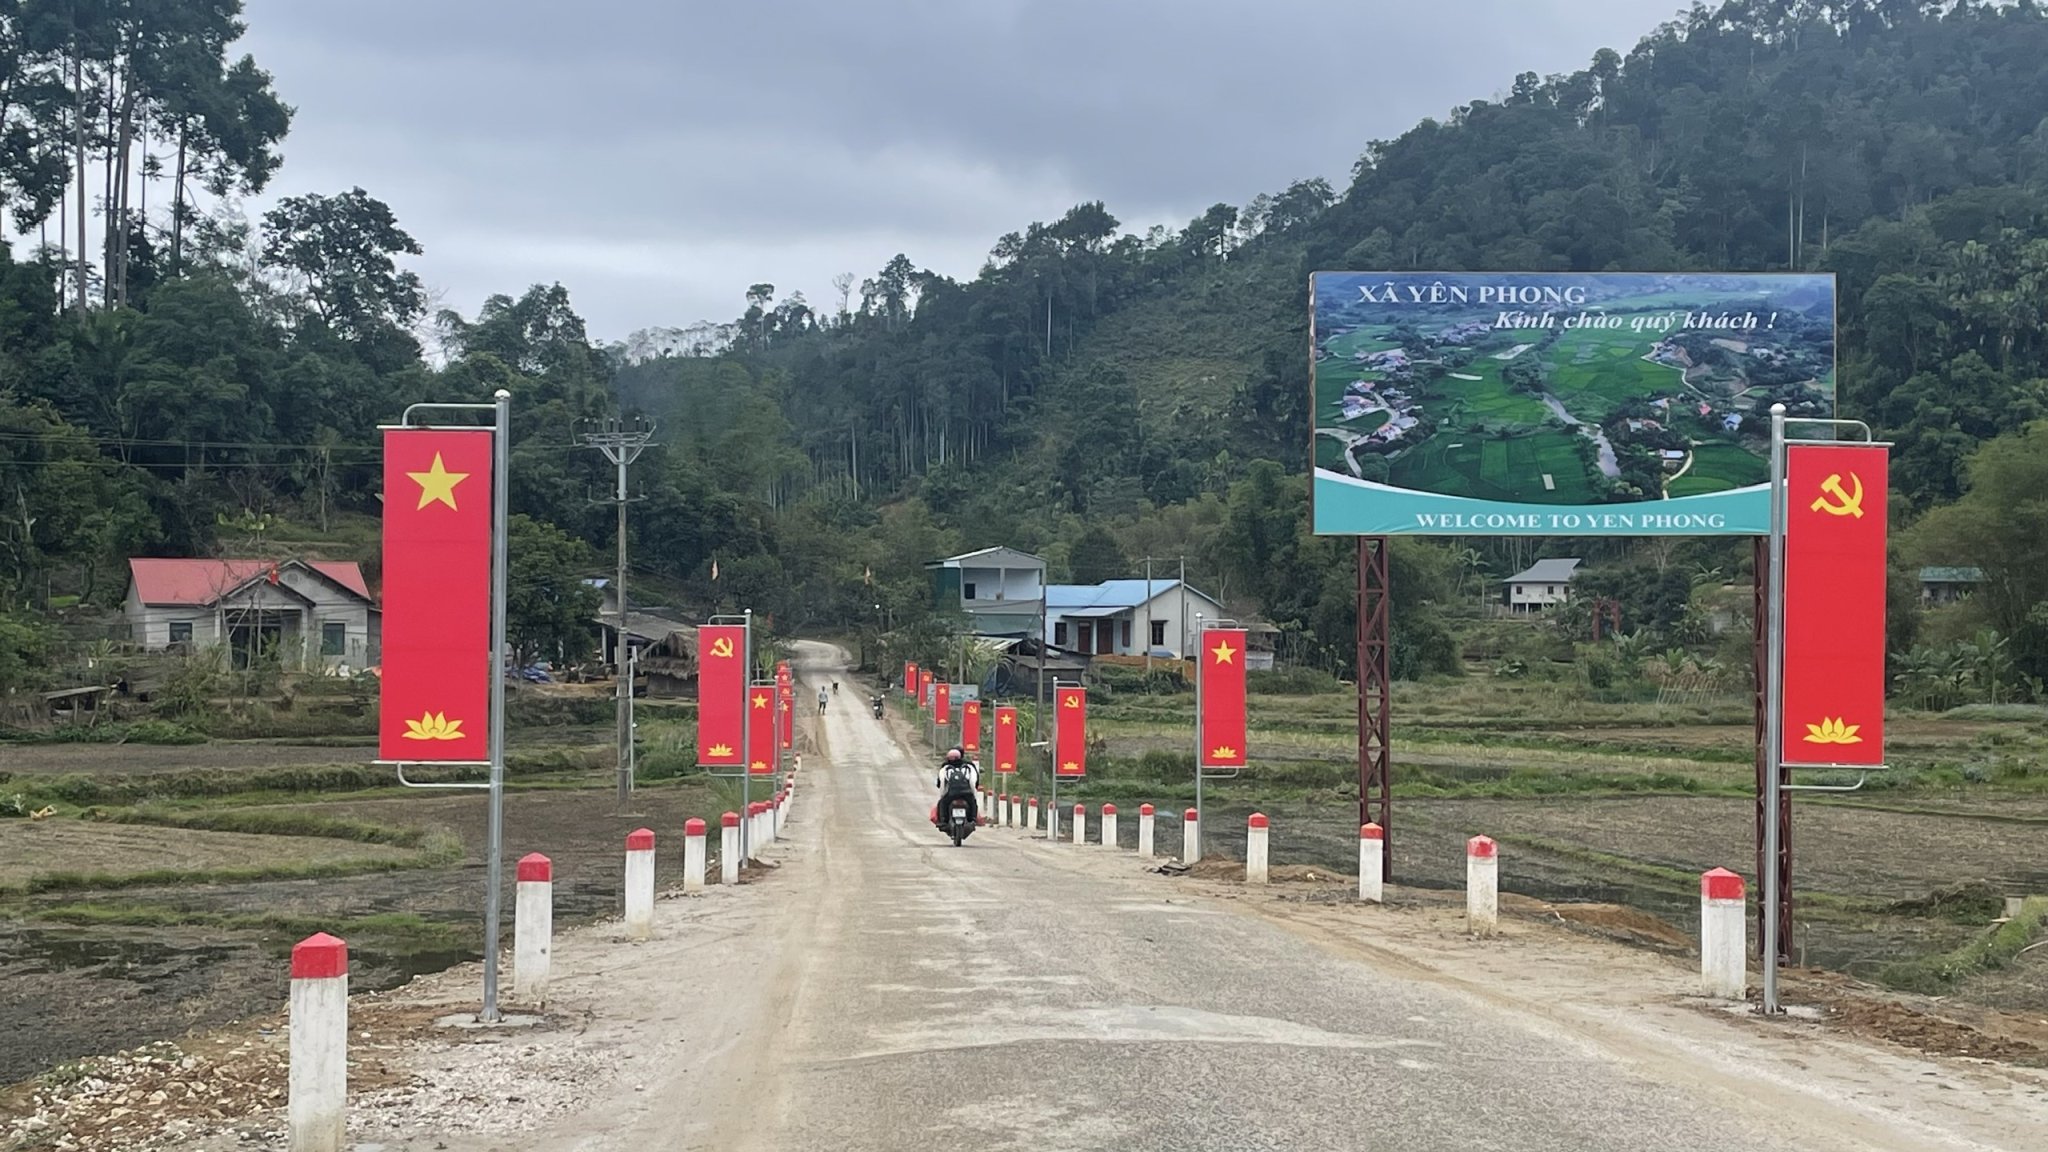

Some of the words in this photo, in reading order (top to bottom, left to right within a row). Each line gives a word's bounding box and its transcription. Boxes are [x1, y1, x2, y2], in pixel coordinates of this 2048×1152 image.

[1358, 281, 1400, 303] XÃ
[1407, 281, 1470, 303] YÊN
[1479, 285, 1586, 304] PHONG
[1494, 311, 1556, 329] Kính
[1563, 311, 1623, 329] chào
[1630, 311, 1677, 334] quý
[1682, 311, 1758, 330] khách
[1767, 311, 1778, 329] !
[1415, 513, 1542, 528] WELCOME
[1547, 513, 1581, 528] TO
[1586, 513, 1635, 528] YEN
[1641, 513, 1726, 528] PHONG
